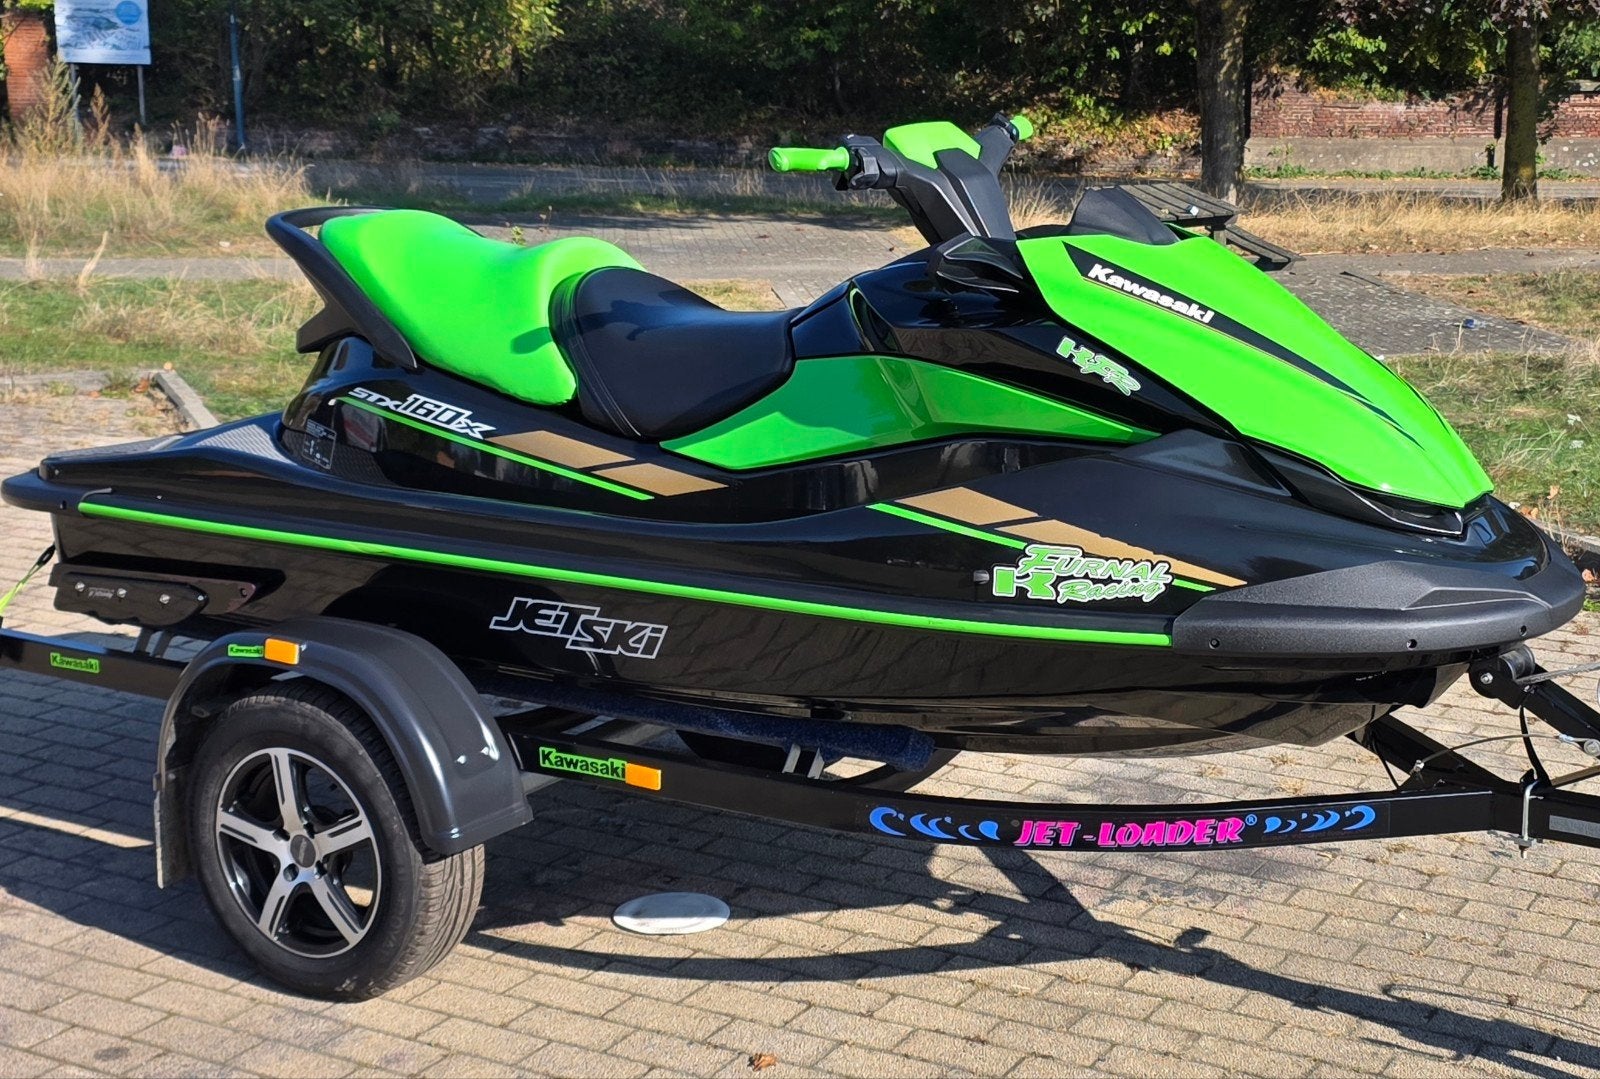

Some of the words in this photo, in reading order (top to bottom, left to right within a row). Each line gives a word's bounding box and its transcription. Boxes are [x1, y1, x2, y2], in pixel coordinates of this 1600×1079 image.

[1087, 263, 1215, 324] Kawasaki
[1017, 544, 1173, 582] FURNAL
[1056, 579, 1166, 604] Racing
[52, 654, 98, 671] Kawasaki
[541, 749, 625, 779] Kawasaki
